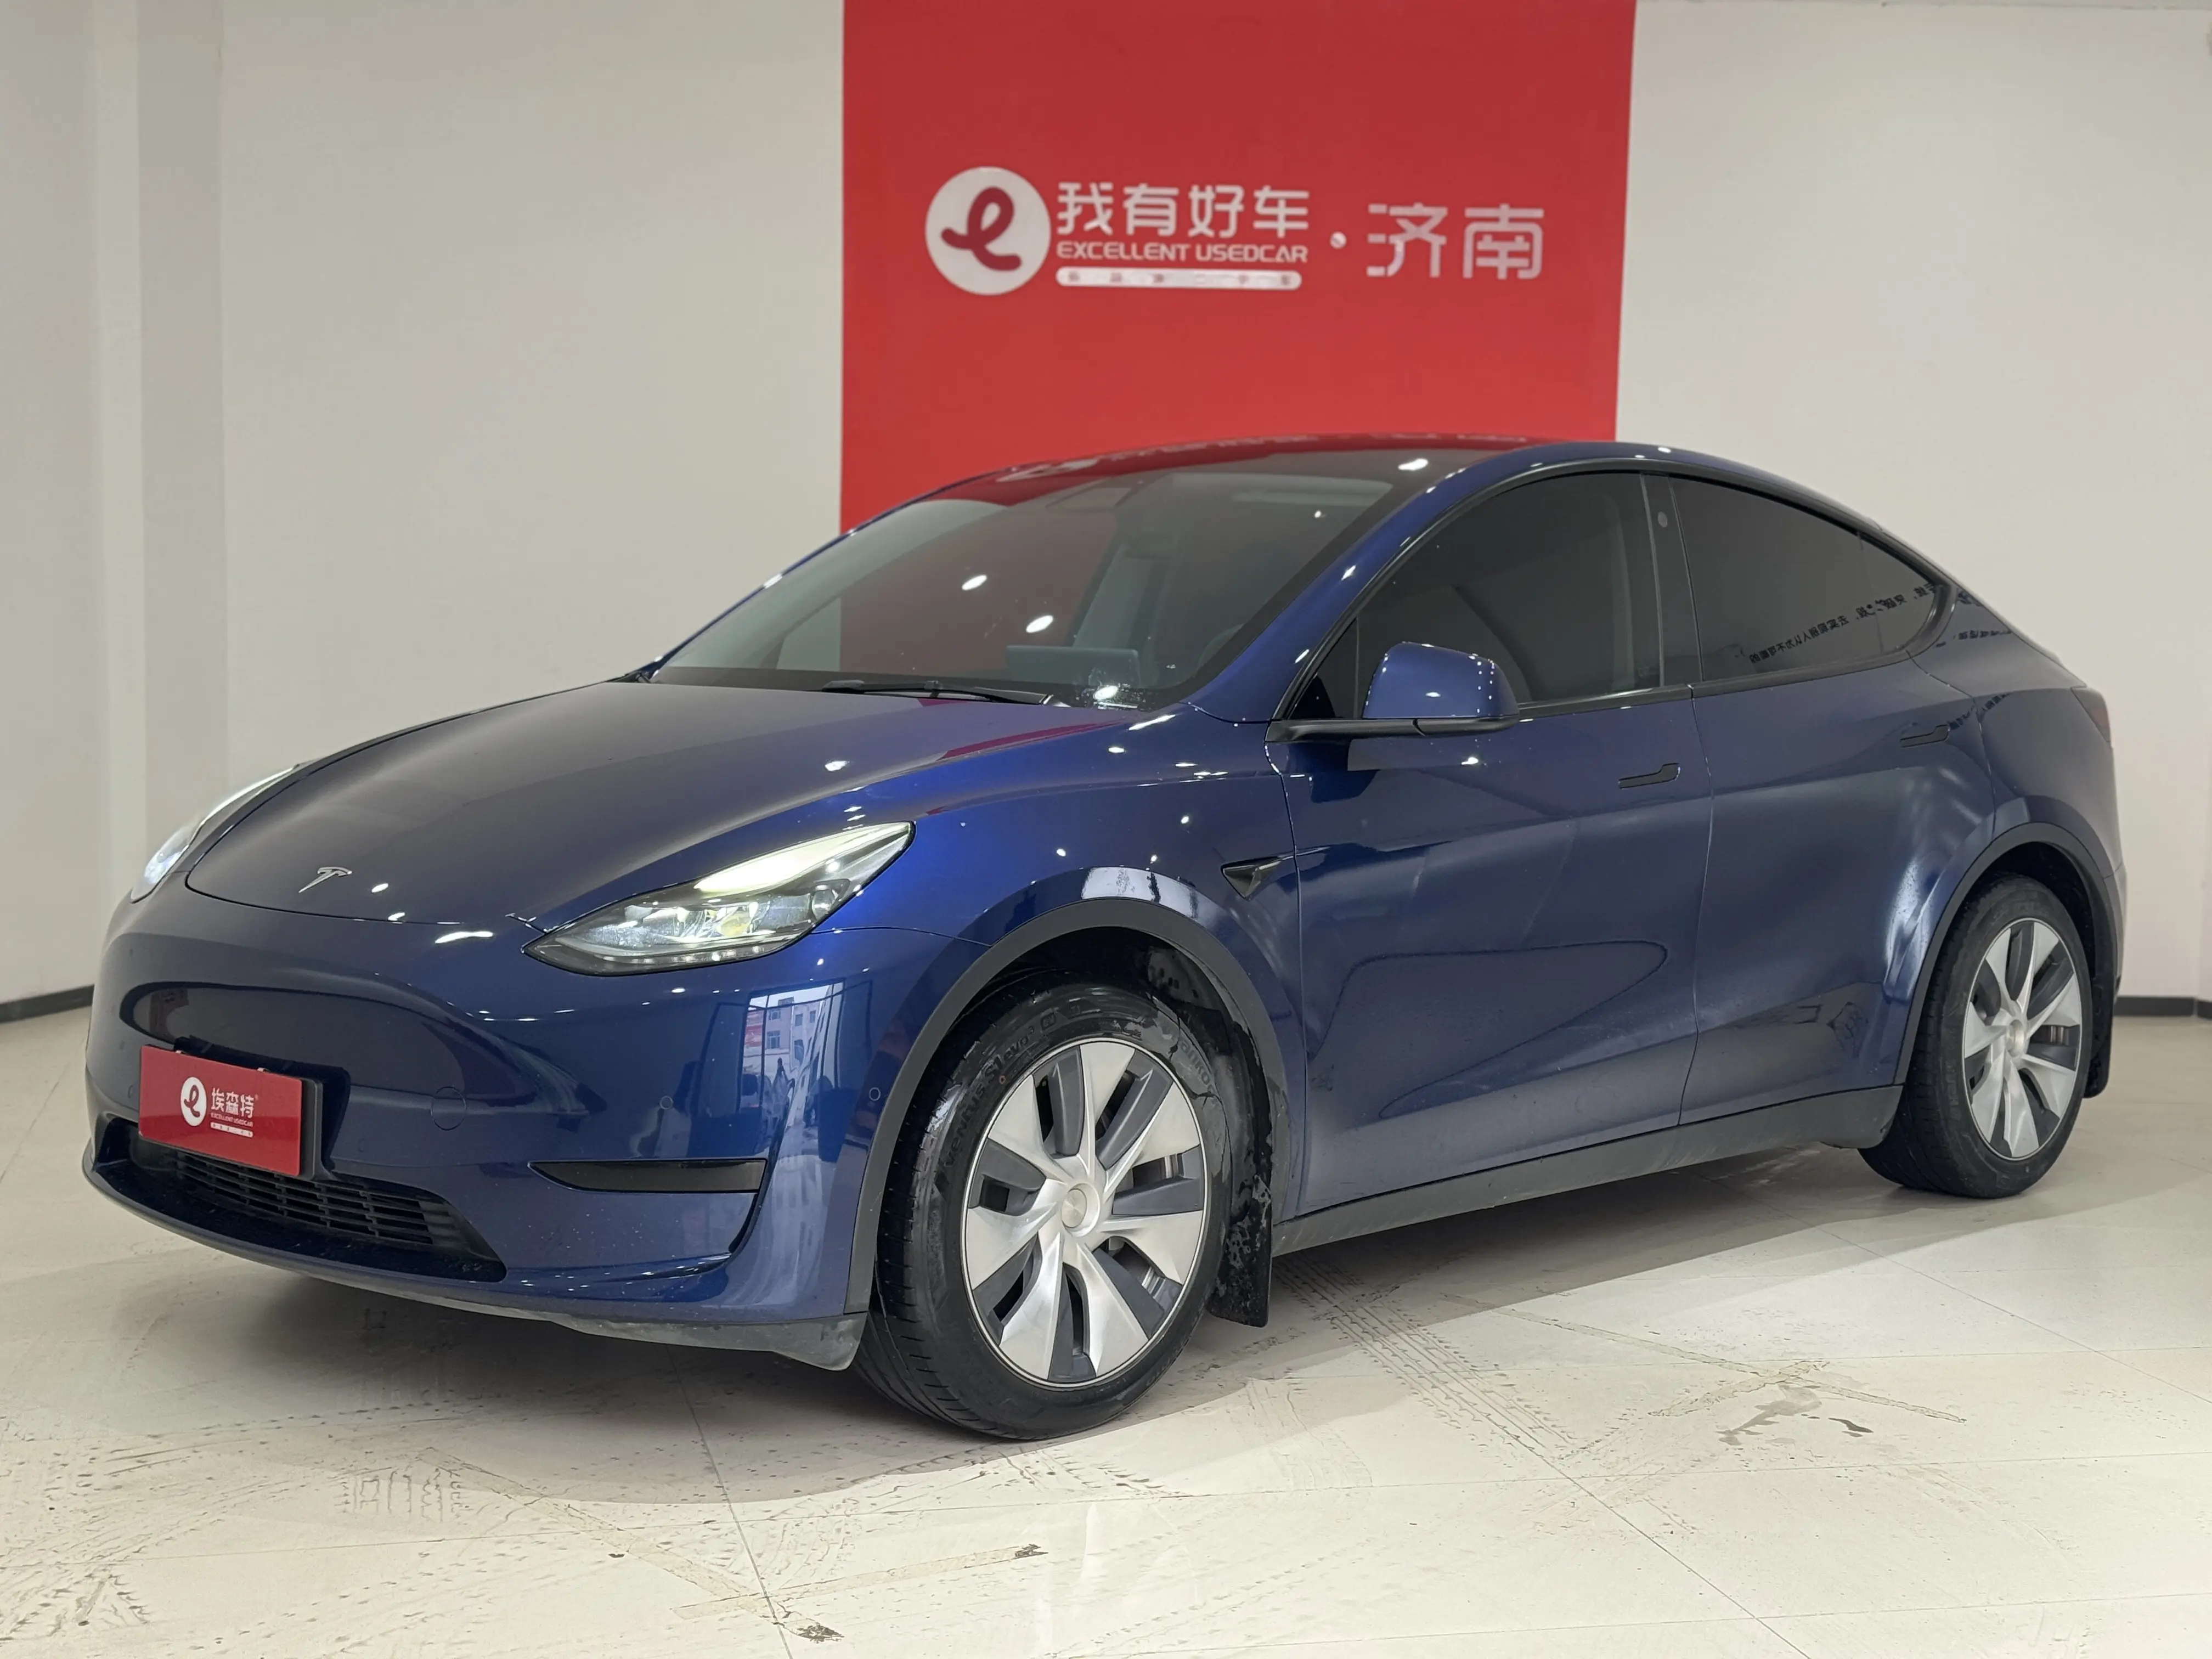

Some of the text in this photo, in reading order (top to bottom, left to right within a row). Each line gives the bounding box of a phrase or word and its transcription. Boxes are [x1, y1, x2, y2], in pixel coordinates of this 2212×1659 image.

[1057, 182, 1310, 239] 我有好车
[1056, 240, 1308, 263] EXCELLENT USEDCAR
[211, 1087, 254, 1119] 埃森特
